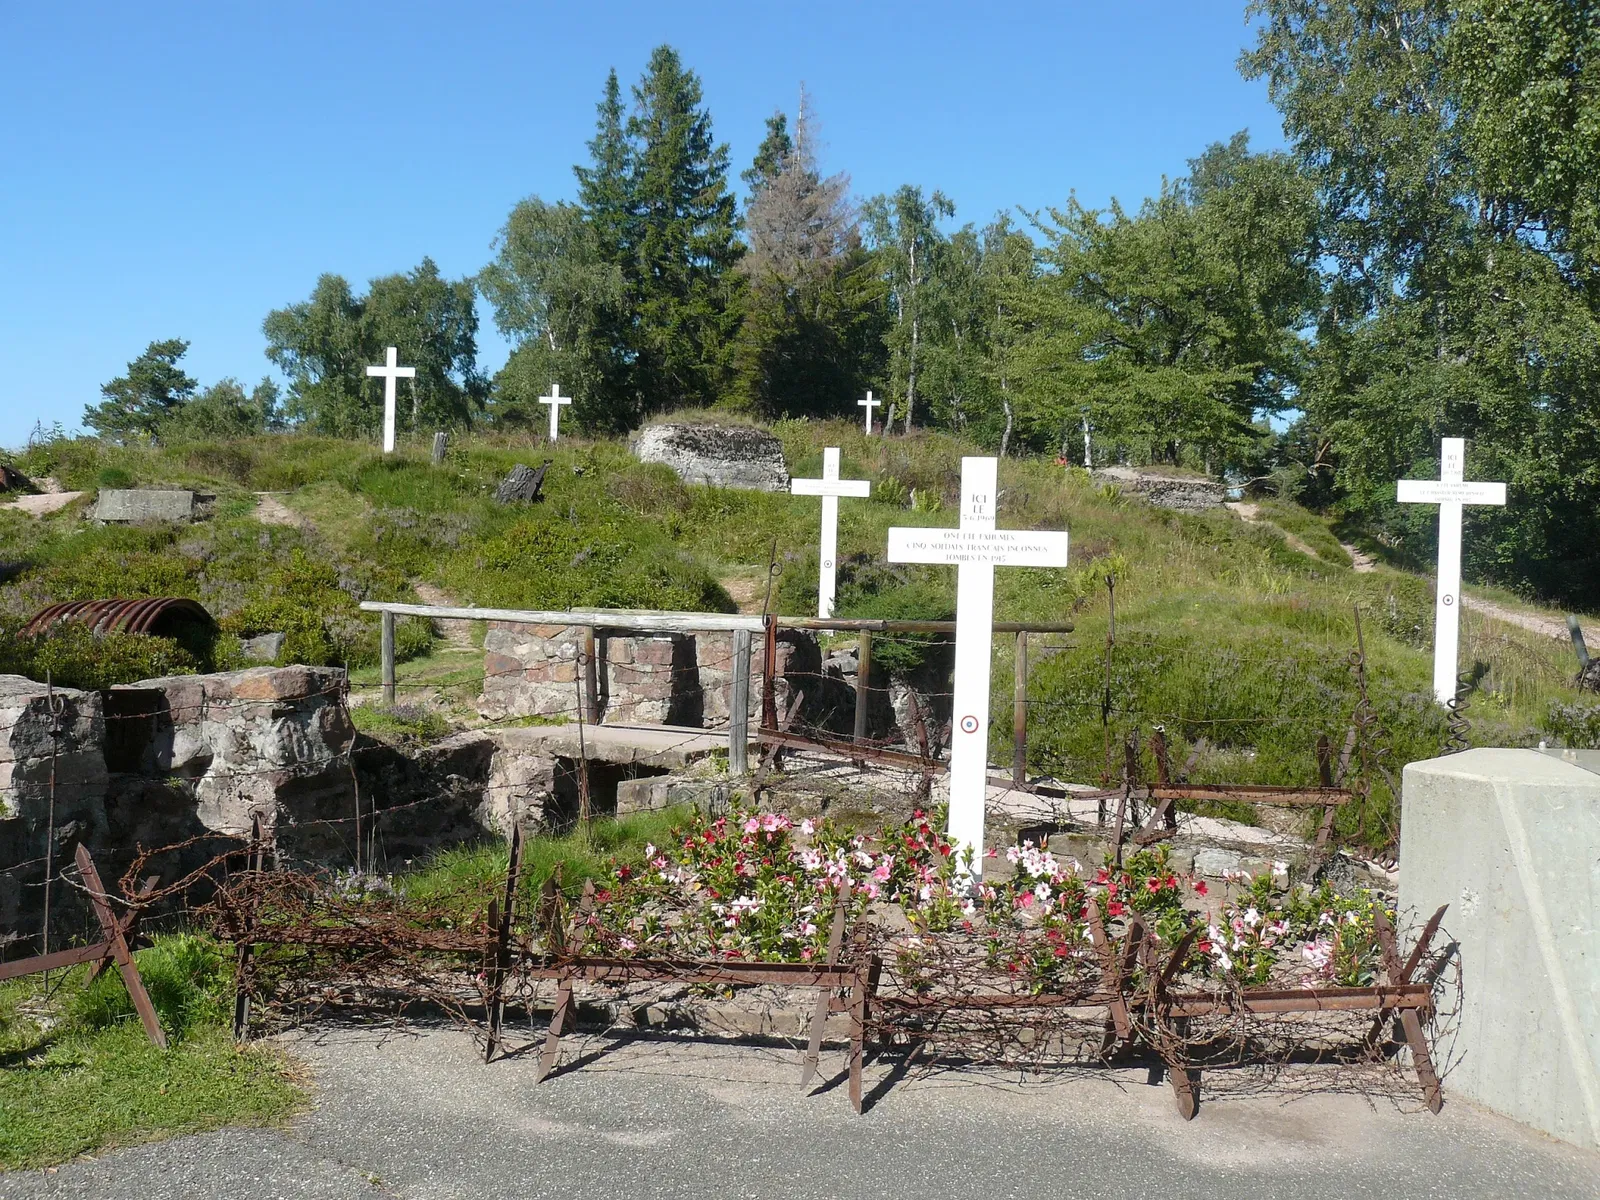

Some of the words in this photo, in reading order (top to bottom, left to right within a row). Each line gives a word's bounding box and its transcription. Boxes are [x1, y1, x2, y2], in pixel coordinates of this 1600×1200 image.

[972, 494, 986, 503] ICI
[973, 505, 985, 514] LE
[943, 532, 960, 540] ONT
[979, 533, 1015, 541] EXHUMES
[906, 542, 927, 550] CINQ
[991, 555, 1007, 563] 1915
